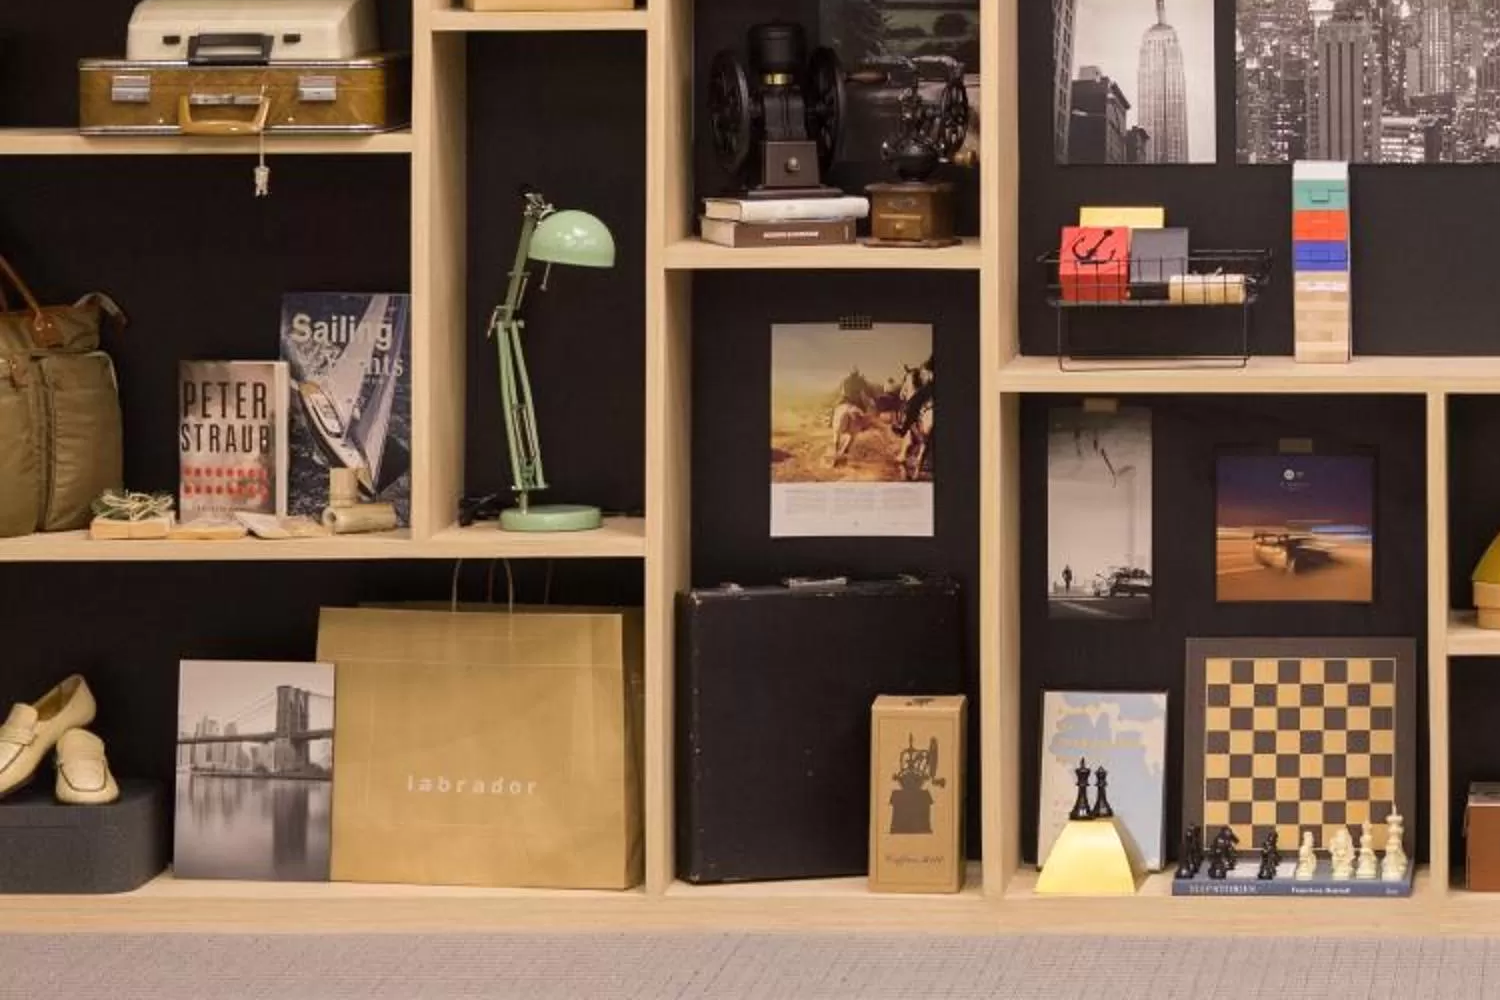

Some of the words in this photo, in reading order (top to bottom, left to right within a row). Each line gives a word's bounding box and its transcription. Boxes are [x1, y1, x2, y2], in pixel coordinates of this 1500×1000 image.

[183, 381, 267, 420] PETER
[181, 423, 270, 454] STRAUB
[407, 774, 538, 794] labrador
